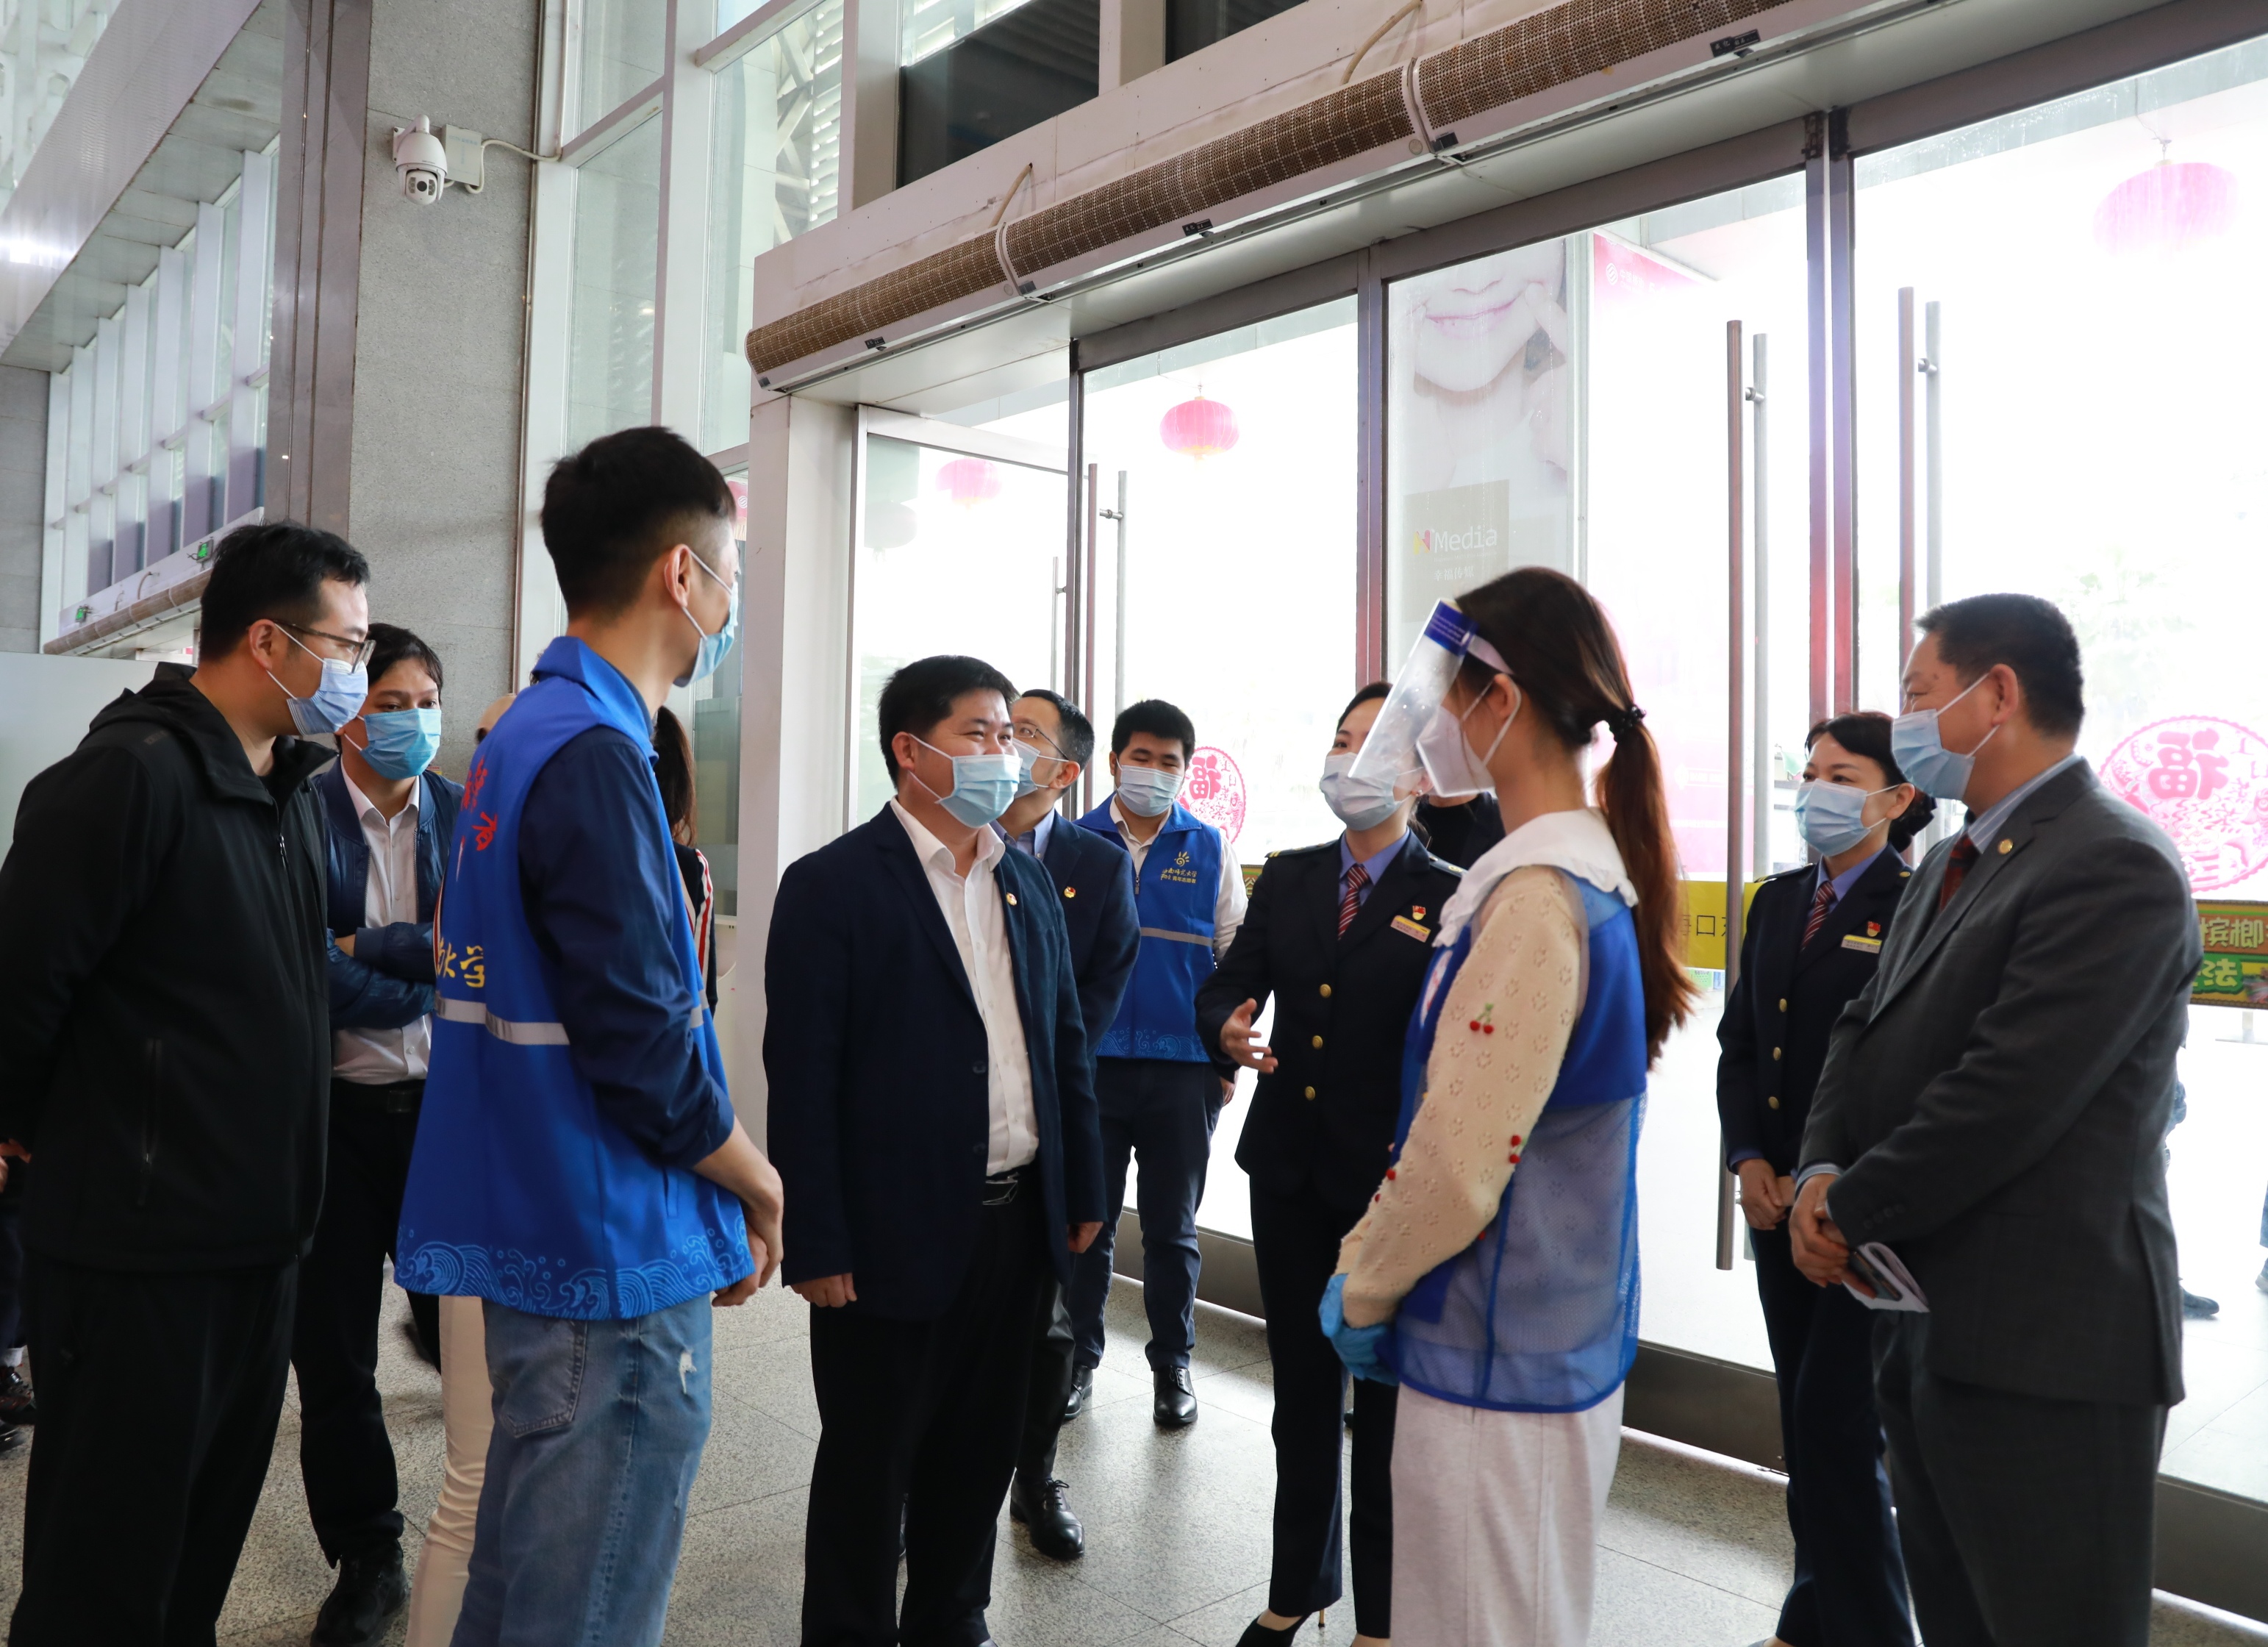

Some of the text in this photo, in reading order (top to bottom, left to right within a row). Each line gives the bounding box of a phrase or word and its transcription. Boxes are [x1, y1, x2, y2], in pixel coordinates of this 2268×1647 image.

[1434, 566, 1474, 582] 幸福传媒
[2200, 917, 2268, 948] 槟榔
